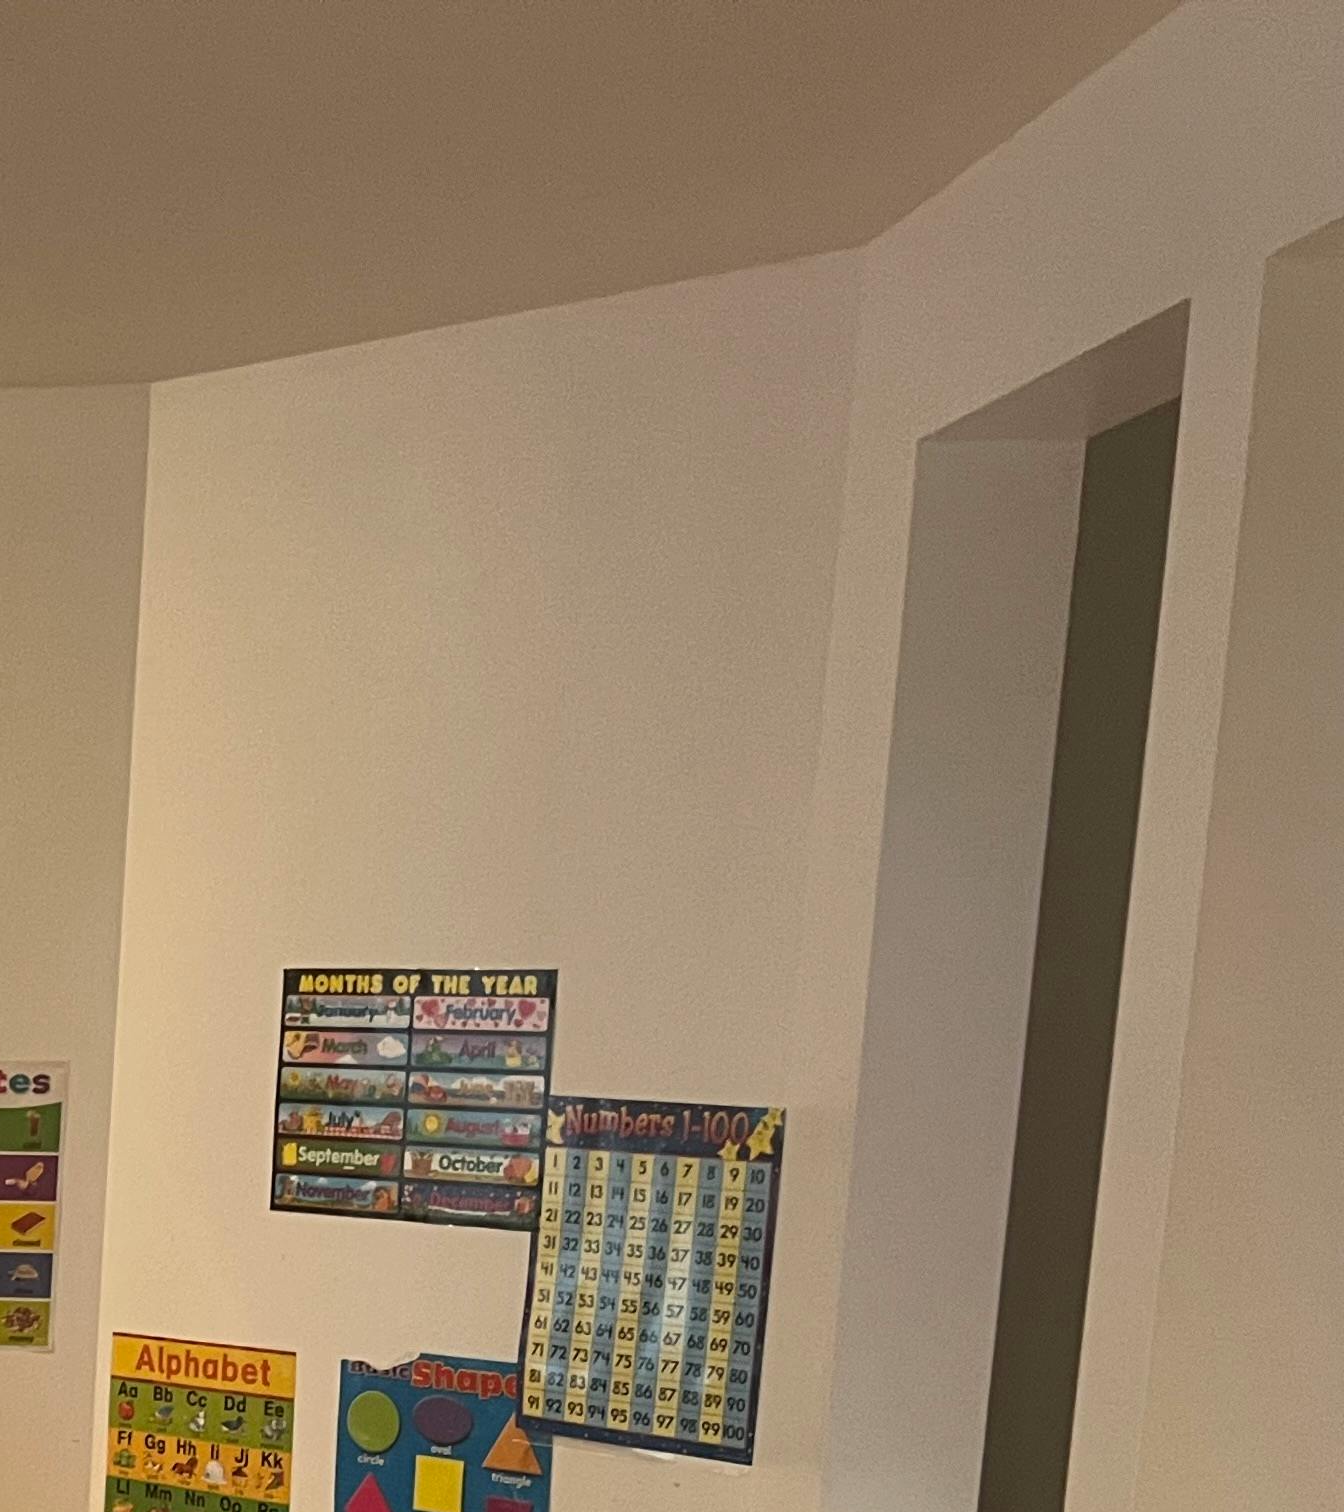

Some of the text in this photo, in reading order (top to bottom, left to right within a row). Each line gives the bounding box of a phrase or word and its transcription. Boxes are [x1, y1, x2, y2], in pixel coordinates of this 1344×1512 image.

[299, 975, 537, 996] MONTHS OF THE YEAR
[318, 1005, 378, 1022] January
[446, 1005, 516, 1025] February
[321, 1039, 367, 1054] March
[459, 1042, 496, 1058] April
[326, 1110, 355, 1130] July
[446, 1118, 500, 1137] August
[563, 1104, 674, 1138] Numbers
[298, 1147, 379, 1167] September
[438, 1154, 503, 1174] October
[552, 1154, 558, 1168] 1
[572, 1156, 581, 1170] 2
[595, 1157, 603, 1171] 3
[639, 1160, 647, 1175] 5
[661, 1162, 669, 1176] 6
[682, 1164, 693, 1178] 7
[729, 1168, 740, 1182] 9
[296, 1181, 370, 1201] November
[545, 1208, 558, 1222] 21
[565, 1210, 581, 1225] 22
[586, 1212, 602, 1227] 23
[629, 1216, 646, 1231] 25
[673, 1220, 691, 1235] 27
[720, 1225, 738, 1240] 29
[743, 1226, 762, 1242] 30
[135, 1344, 272, 1387] Alphabet
[530, 1342, 544, 1356] 71
[550, 1344, 566, 1360] 72
[571, 1348, 588, 1363] 73
[615, 1354, 632, 1369] 75
[637, 1356, 654, 1372] 76
[660, 1359, 679, 1374] 77
[684, 1362, 701, 1378] 78
[705, 1365, 724, 1380] 79
[118, 1382, 284, 1417] Aa Bb Cc Dd Ee
[117, 1431, 283, 1469] Ff Gg Hh Ii Jj Kk
[357, 1454, 385, 1466] circle
[116, 1479, 130, 1495] Ll
[145, 1483, 172, 1501] Mm
[185, 1490, 205, 1507] Nn
